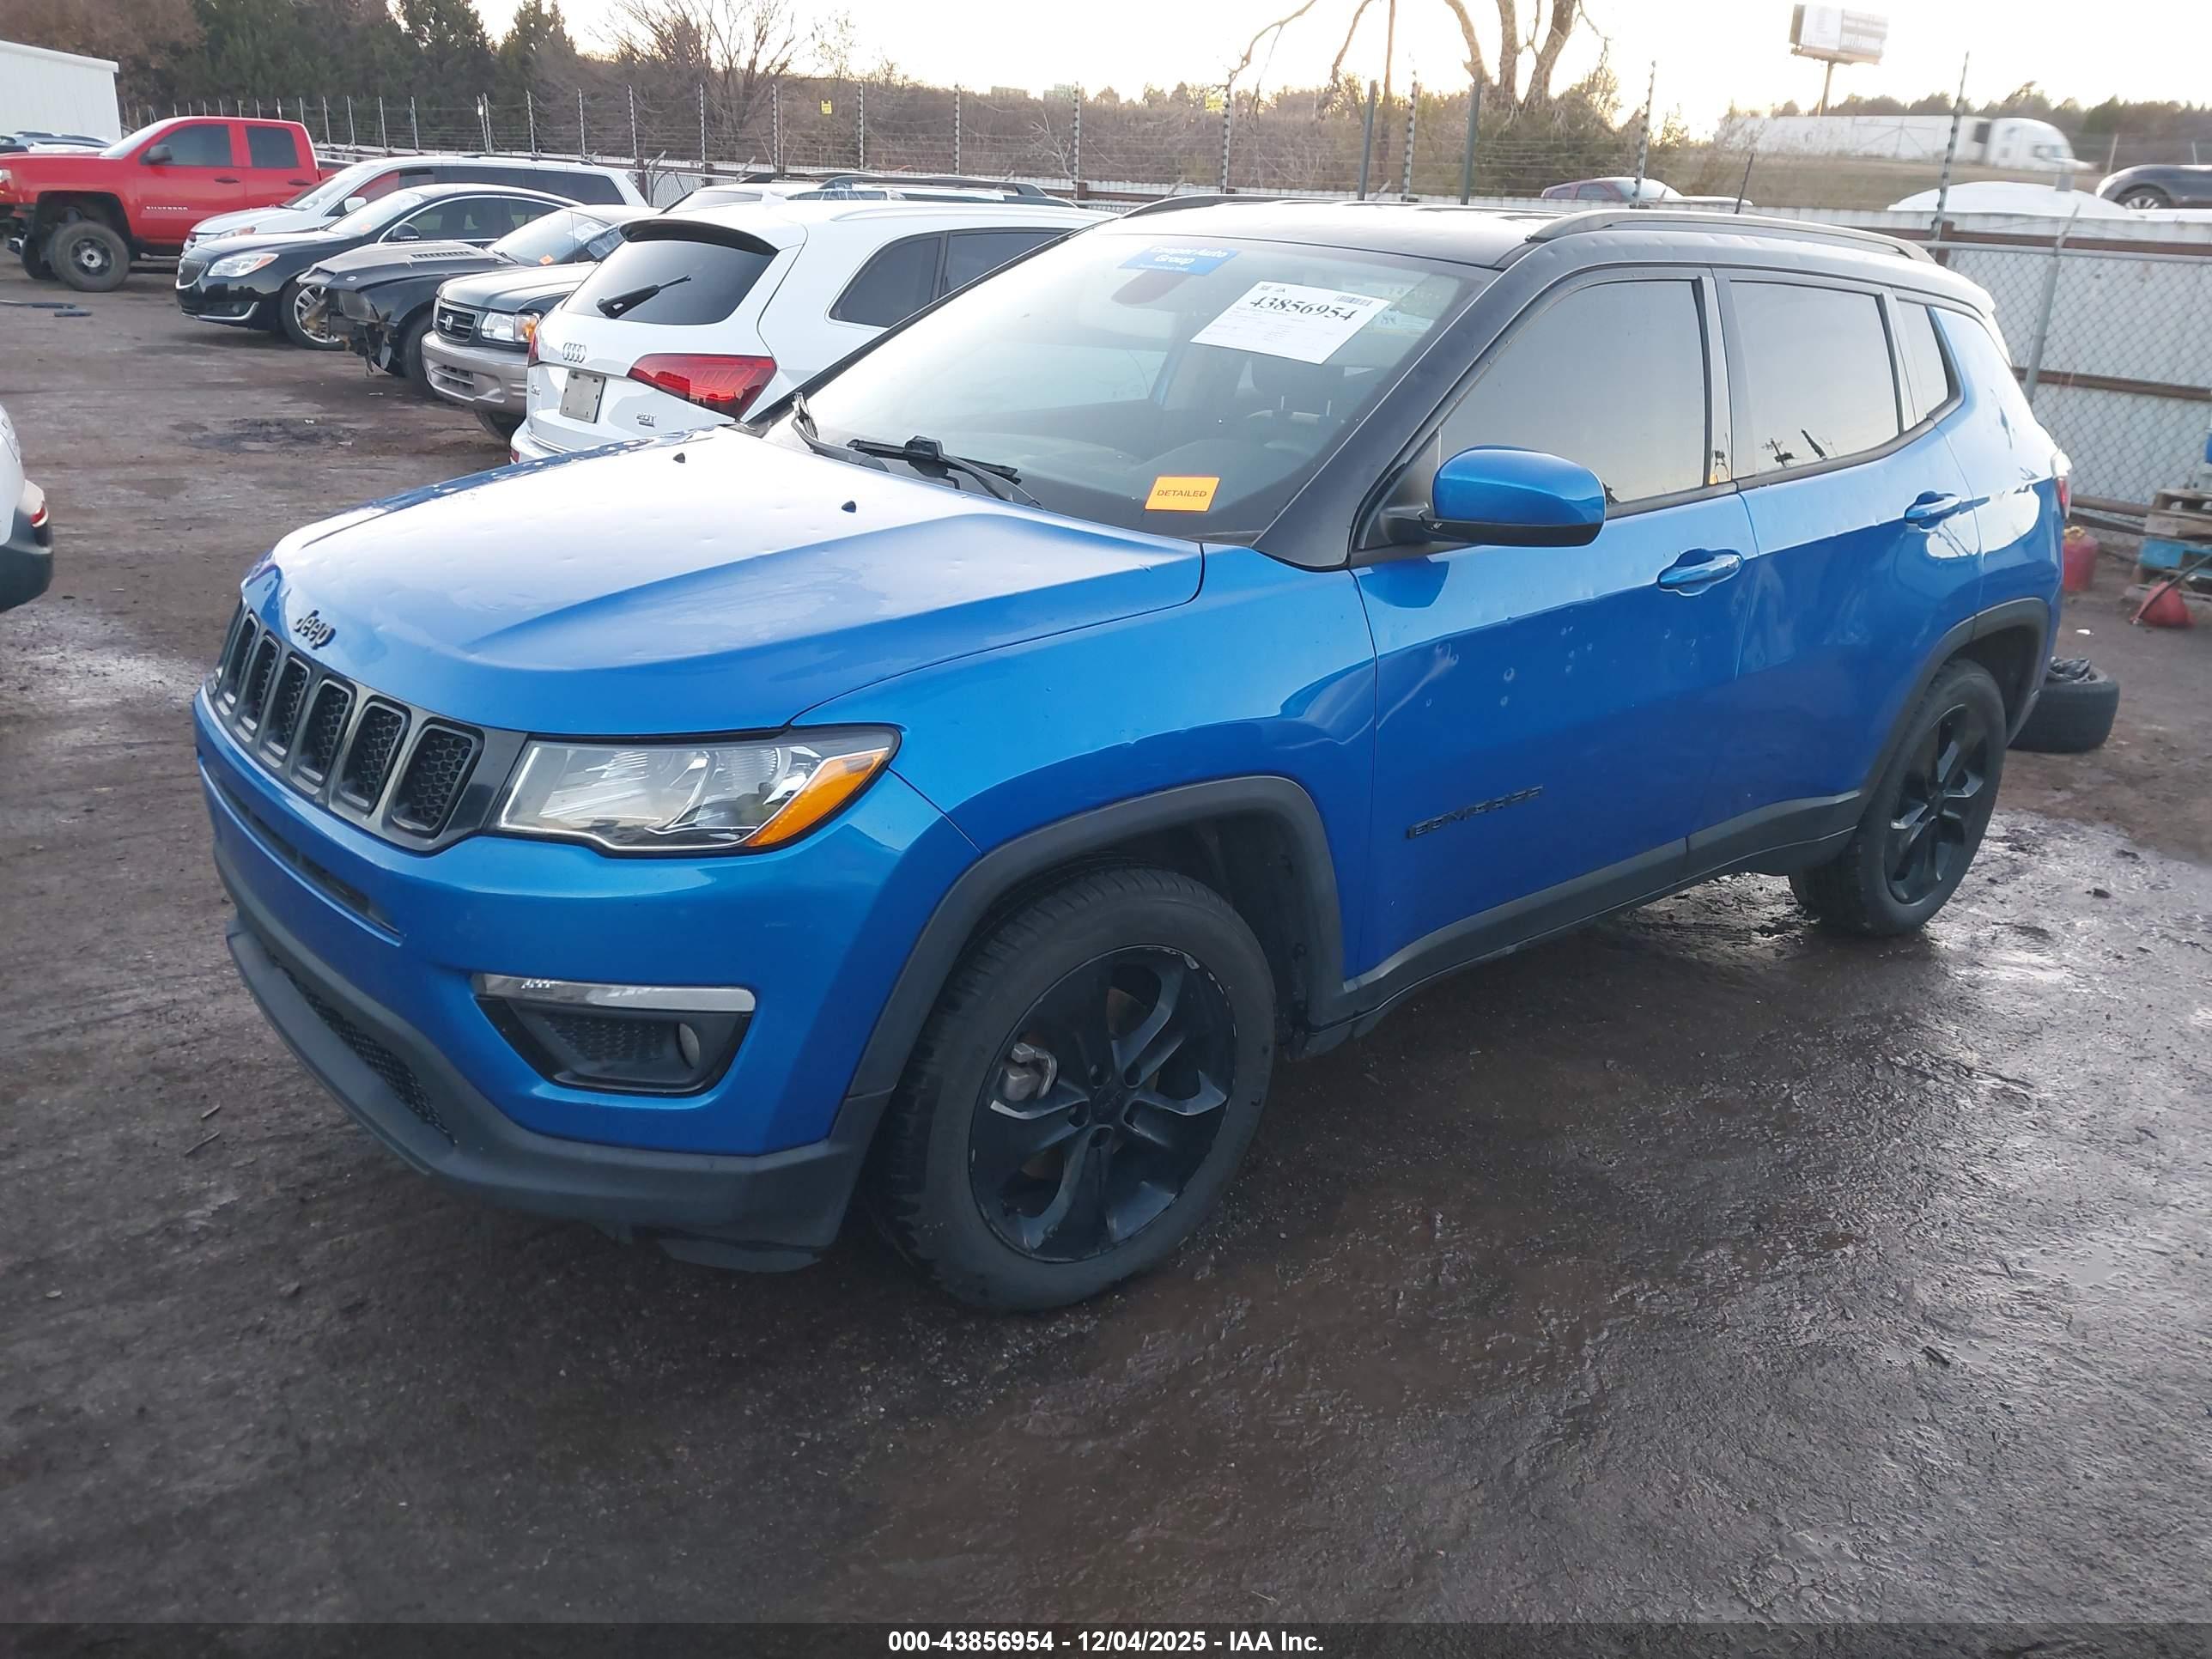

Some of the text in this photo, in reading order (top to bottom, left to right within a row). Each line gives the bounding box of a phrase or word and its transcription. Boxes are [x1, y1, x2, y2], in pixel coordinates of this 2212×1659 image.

[1153, 254, 1196, 264] Group
[1250, 295, 1358, 321] 43856954
[294, 609, 336, 650] Jeep
